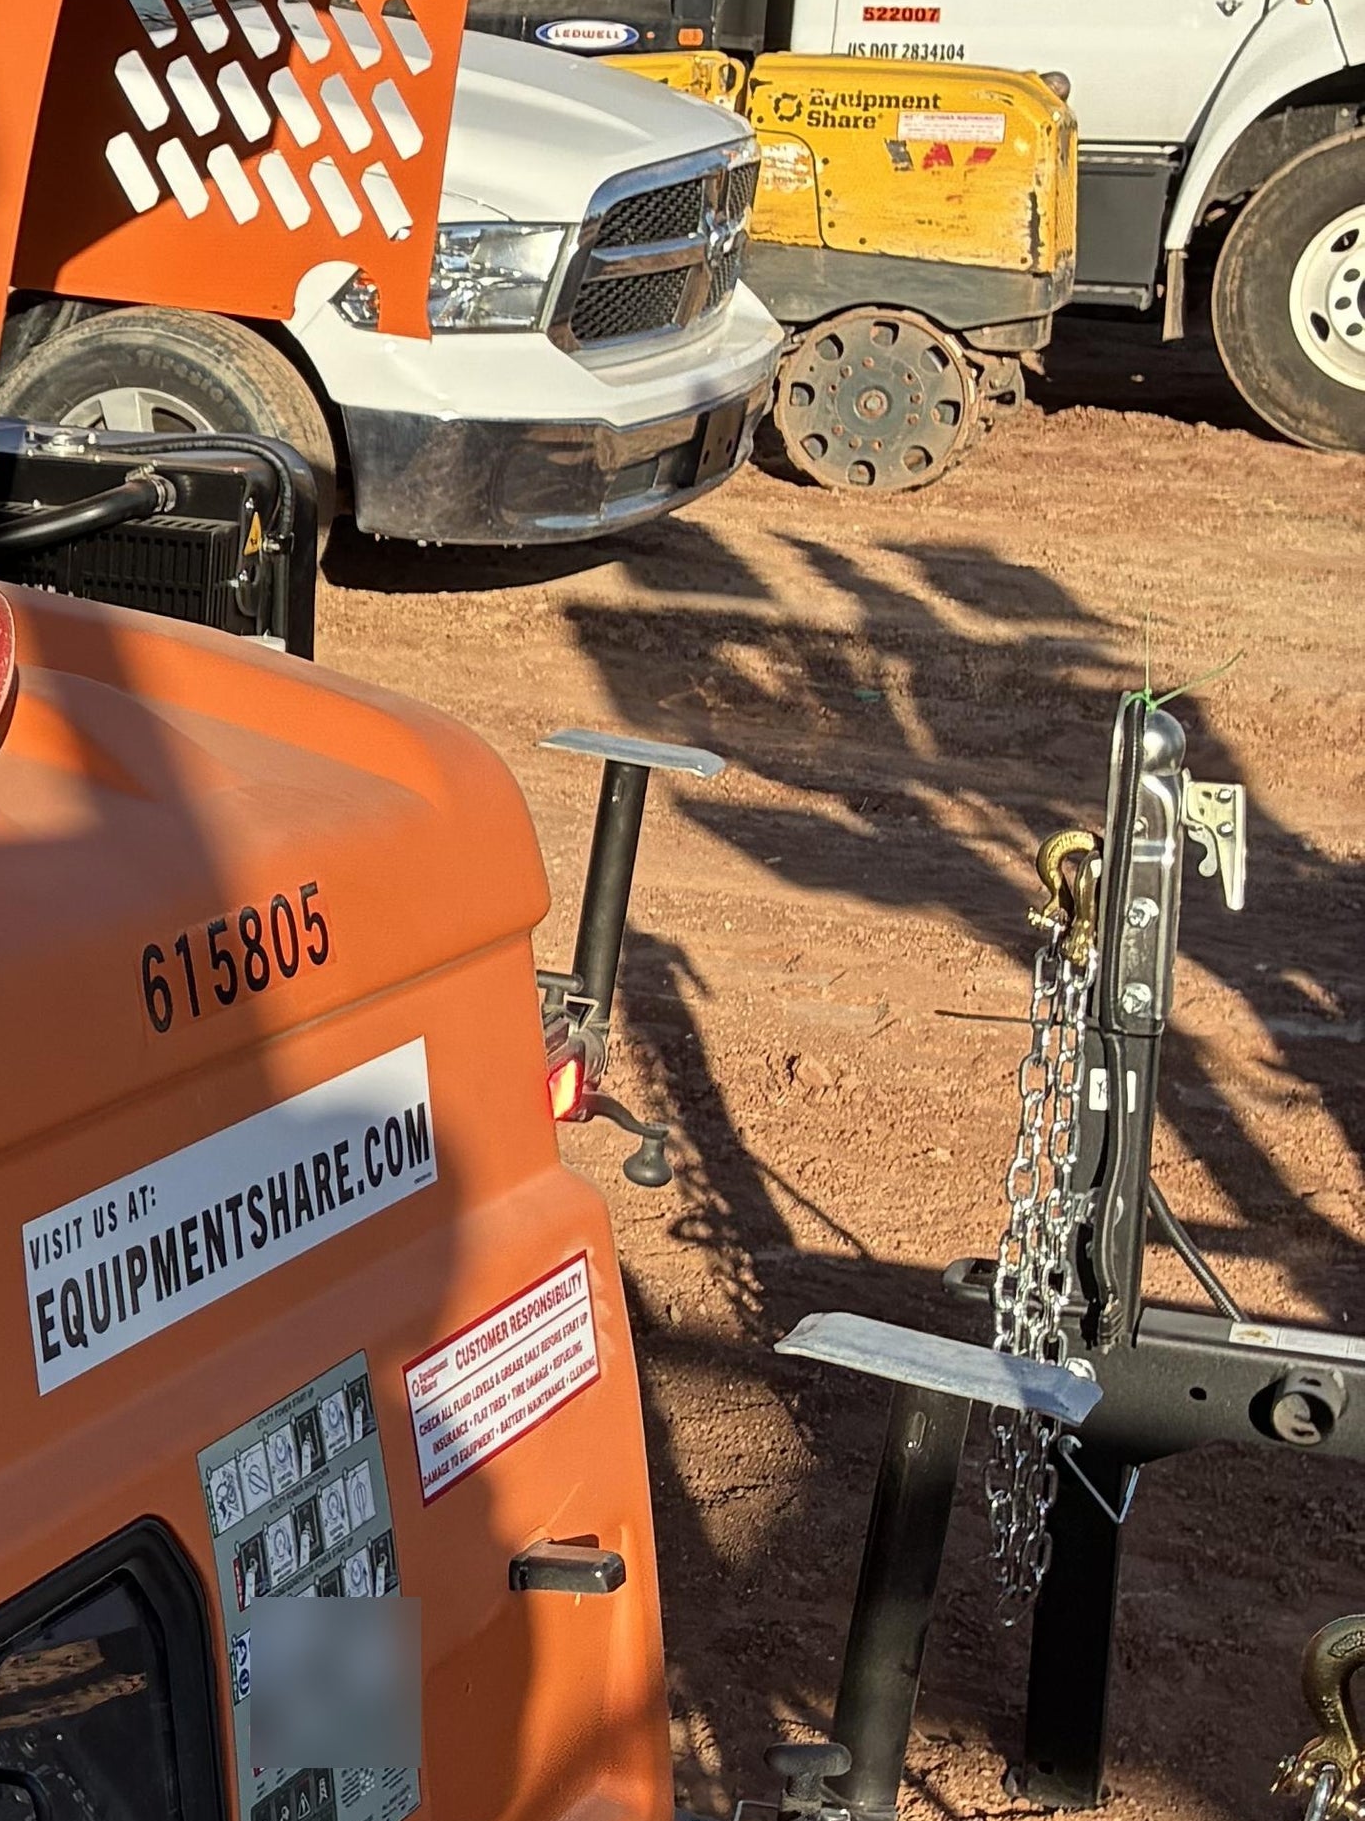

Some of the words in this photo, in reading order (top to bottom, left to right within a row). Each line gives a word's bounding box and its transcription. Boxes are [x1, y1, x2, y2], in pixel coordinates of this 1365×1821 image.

[863, 7, 940, 23] 522007
[554, 29, 620, 39] LEDWELL
[848, 43, 866, 57] US
[870, 43, 898, 59] DOT
[902, 43, 966, 61] 2834104
[806, 111, 877, 129] Share
[140, 881, 330, 1034] 615805
[29, 1217, 83, 1271] VISIT
[93, 1201, 117, 1239] US
[127, 1184, 156, 1224] AT:
[36, 1102, 430, 1364] EQUIPMENTSHARE.COM
[454, 1318, 509, 1370] CUSTOMER
[510, 1270, 583, 1334] RESPONSIBILITY
[419, 1414, 440, 1437] CHECK
[441, 1405, 453, 1423] ALL
[423, 1461, 450, 1489] DAMAGE
